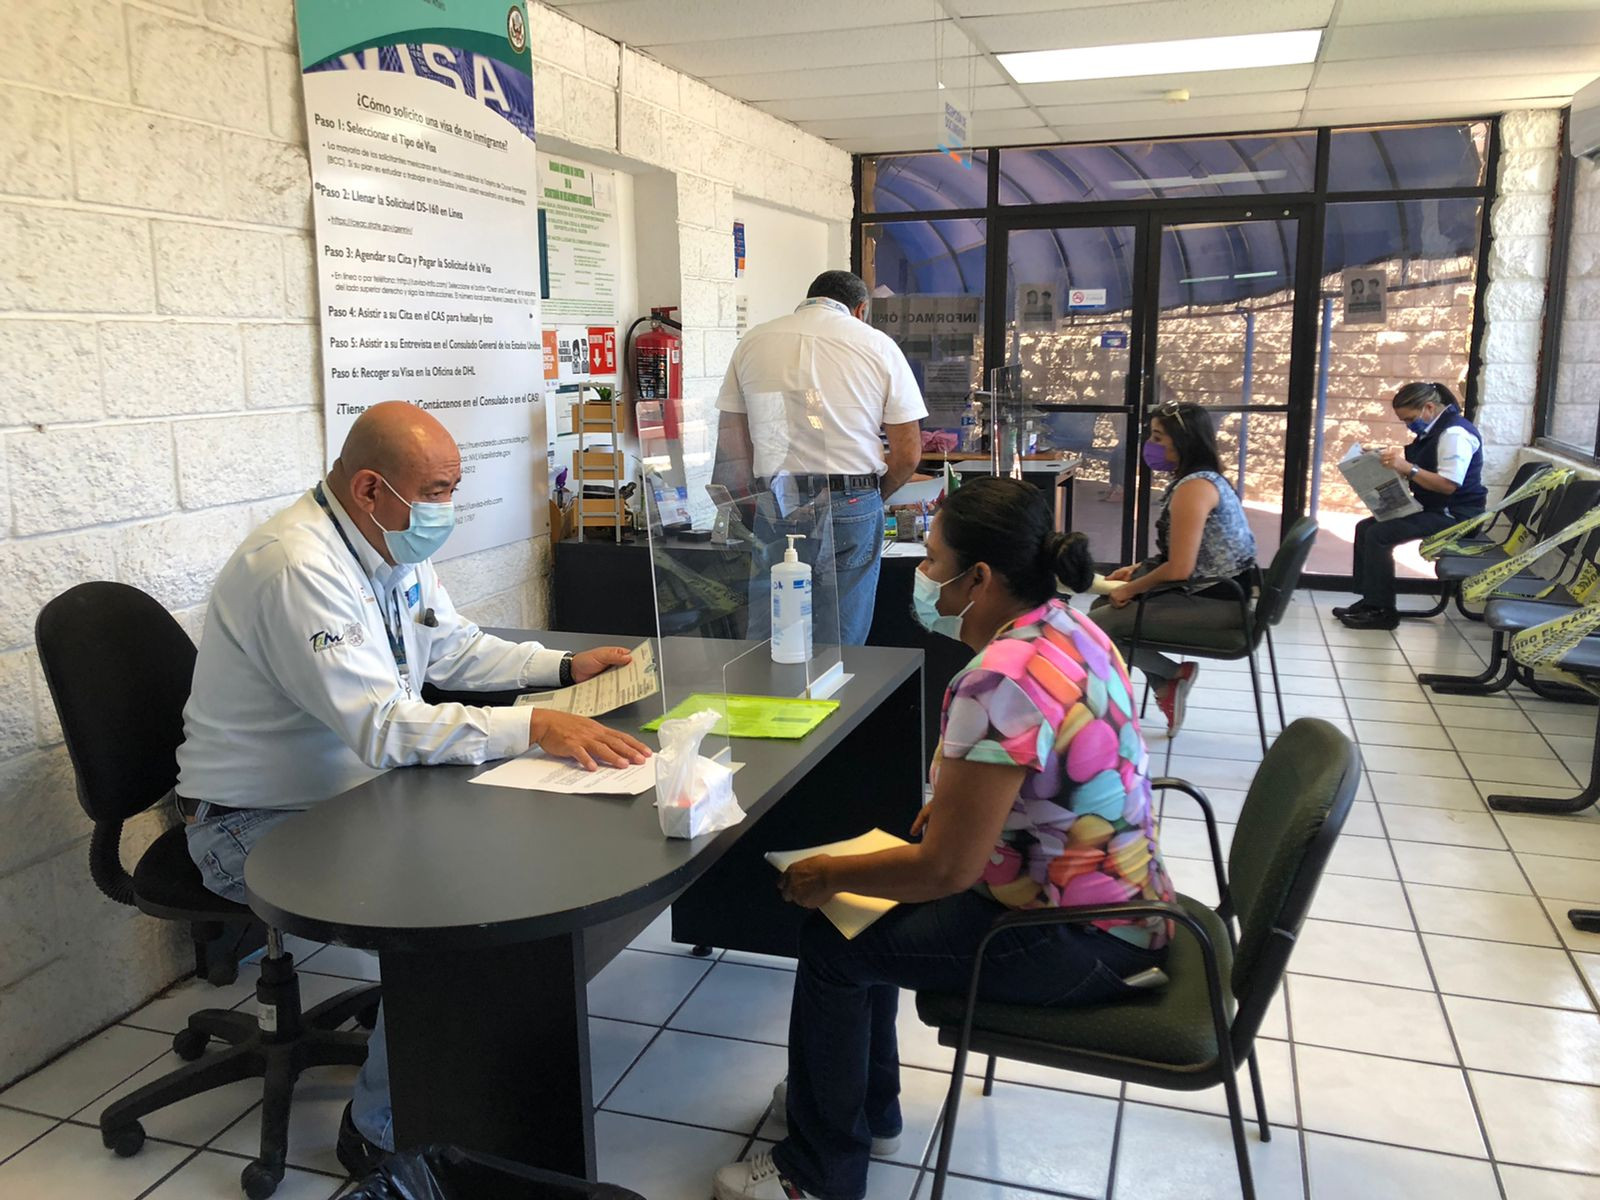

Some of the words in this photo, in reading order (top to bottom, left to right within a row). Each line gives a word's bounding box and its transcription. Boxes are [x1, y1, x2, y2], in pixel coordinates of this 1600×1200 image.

[314, 113, 335, 128] Paso
[338, 119, 345, 131] 1:
[346, 121, 390, 141] Seleccionar
[391, 132, 398, 143] el
[399, 133, 415, 148] Tipo
[416, 139, 424, 149] de
[424, 139, 437, 153] Visa
[393, 107, 424, 123] solicito
[425, 117, 439, 128] una
[439, 119, 453, 133] visa
[454, 124, 462, 136] de
[464, 129, 472, 139] no
[473, 130, 508, 150] inmigrante?
[320, 185, 340, 198] Paso
[342, 188, 350, 200] 2:
[352, 190, 376, 204] Llenar
[377, 194, 384, 206] la
[385, 196, 415, 211] Solicitud
[416, 201, 439, 215] DS-160
[440, 207, 448, 216] en
[324, 245, 344, 258] Paso
[346, 247, 353, 258] 3:
[355, 248, 386, 263] Agendar
[388, 255, 396, 263] su
[397, 253, 412, 264] Cita
[418, 255, 436, 269] Pagar
[437, 258, 443, 268] la
[444, 258, 468, 271] Solicitud
[469, 262, 475, 272] de
[481, 263, 492, 274] Visa
[335, 272, 341, 280] En
[360, 285, 381, 294] superior
[328, 306, 347, 317] Paso
[349, 307, 356, 317] 4:
[358, 307, 381, 318] Asistir
[383, 311, 388, 319] a
[389, 311, 397, 319] su
[399, 309, 413, 320] Cita
[414, 312, 423, 320] en
[424, 311, 430, 320] el
[431, 311, 445, 321] CAS
[446, 314, 459, 324] para
[460, 313, 478, 323] huellas
[330, 337, 349, 348] Paso
[351, 337, 358, 348] 5:
[359, 337, 383, 348] Asistir
[384, 340, 389, 348] a
[390, 340, 398, 348] su
[400, 338, 432, 349] Entrevista
[433, 341, 441, 349] en
[442, 339, 447, 349] el
[448, 339, 478, 349] Consulado
[478, 339, 497, 350] General
[498, 340, 504, 350] de
[511, 340, 527, 350] Estados
[331, 367, 350, 378] Paso
[352, 367, 359, 378] 6:
[361, 367, 390, 380] Recoger
[399, 366, 414, 377] Visa
[415, 369, 424, 377] en
[425, 366, 431, 376] la
[432, 366, 453, 376] Oficina
[454, 366, 461, 376] de
[462, 366, 476, 376] DHL
[463, 400, 471, 408] en
[472, 396, 478, 407] el
[479, 394, 508, 406] Consulado
[514, 395, 521, 403] en
[522, 393, 526, 403] el
[336, 403, 365, 415] ¿Tiene
